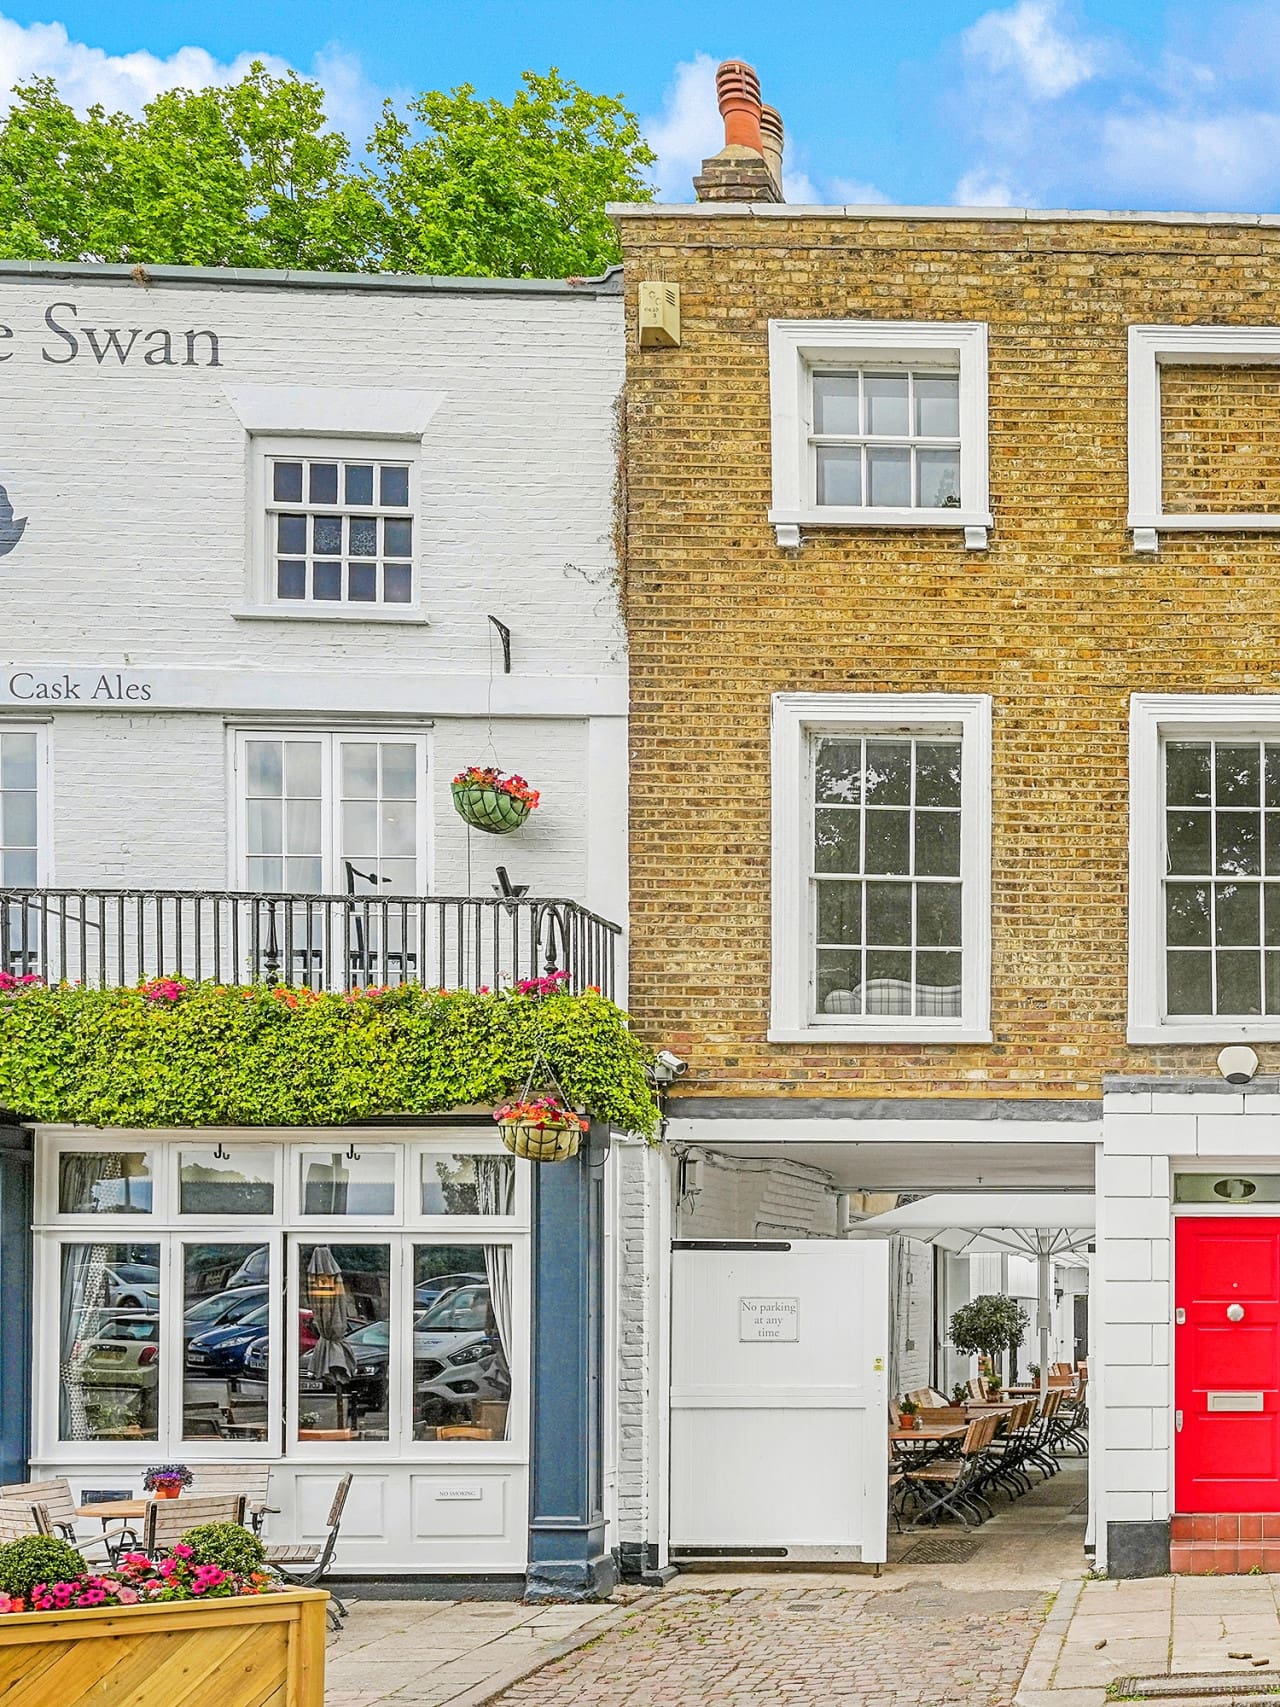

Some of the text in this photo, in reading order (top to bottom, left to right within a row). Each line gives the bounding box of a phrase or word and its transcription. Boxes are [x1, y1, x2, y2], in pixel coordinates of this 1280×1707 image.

[42, 302, 224, 366] Swan
[9, 672, 152, 701] Cask Ales
[742, 1301, 797, 1315] No parking
[766, 1317, 783, 1327] any
[758, 1327, 780, 1337] time
